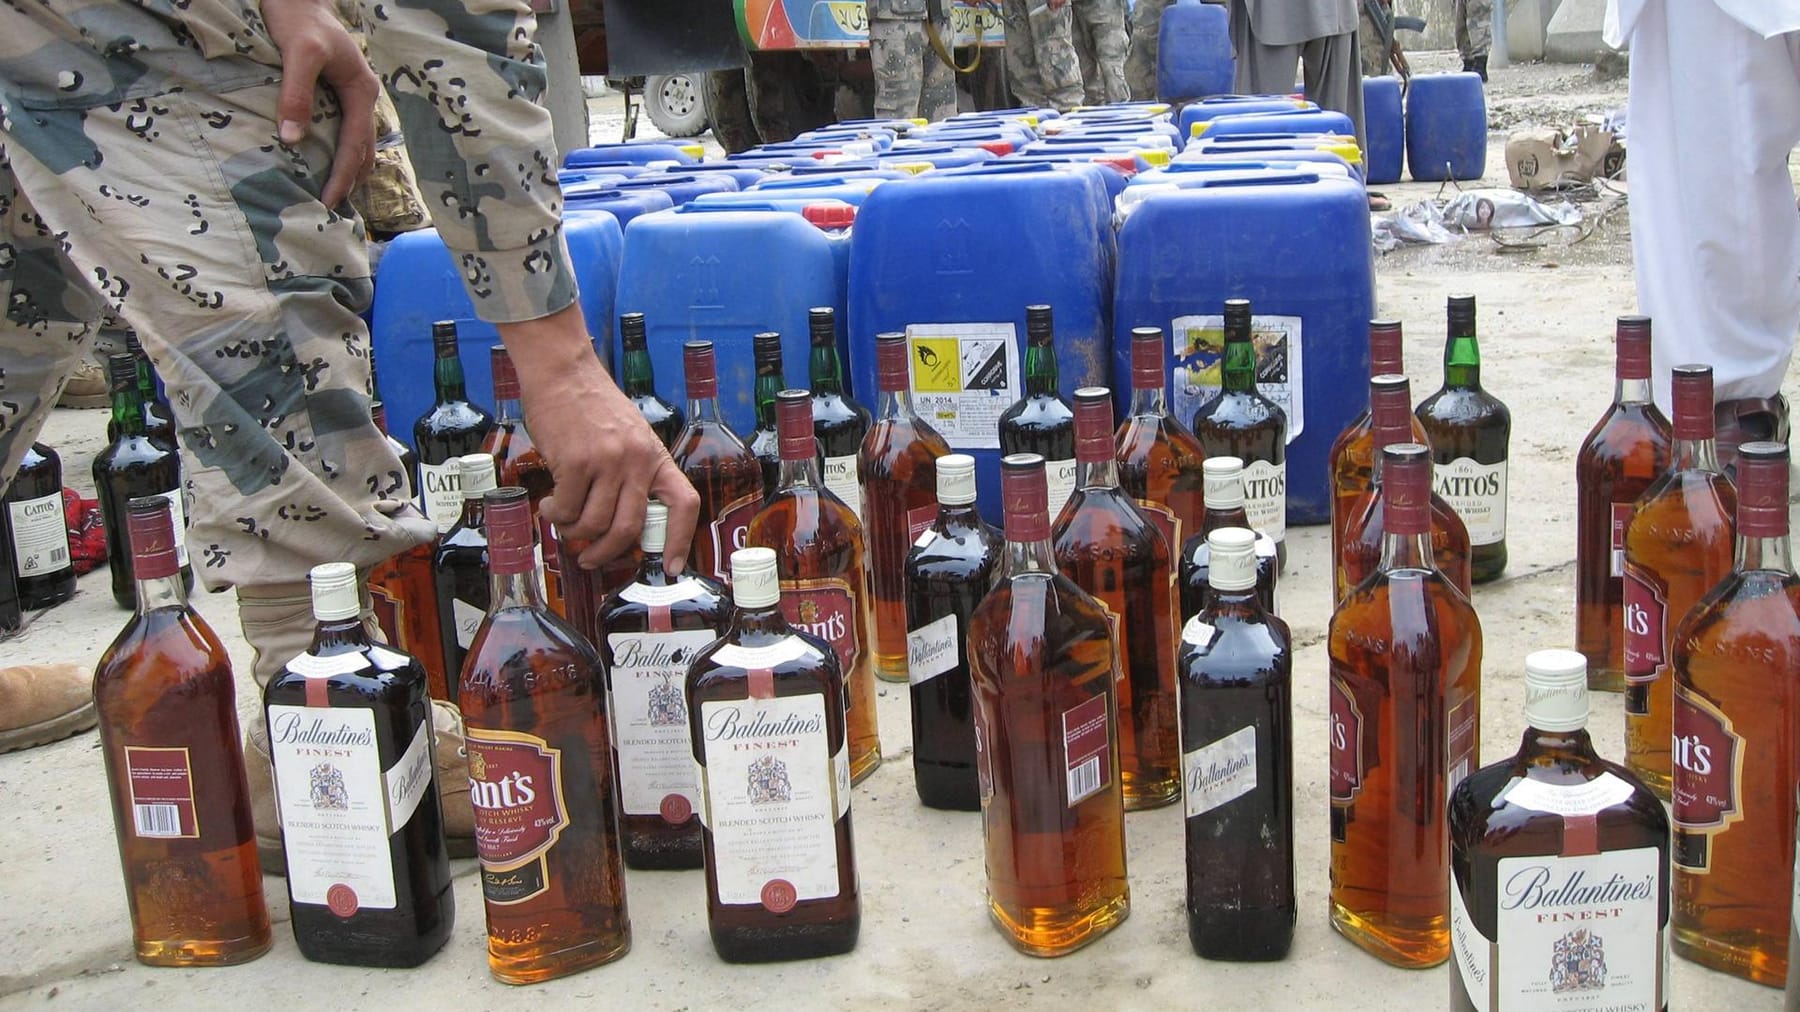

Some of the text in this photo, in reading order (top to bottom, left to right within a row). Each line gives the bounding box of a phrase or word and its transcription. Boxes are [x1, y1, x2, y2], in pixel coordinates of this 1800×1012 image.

[274, 711, 373, 746] Ballantine's
[706, 706, 822, 742] Ballantine's
[296, 748, 353, 758] FINEST
[733, 739, 800, 751] FINEST
[1187, 753, 1250, 793] Ballantine's
[718, 813, 826, 828] BLENDED SCOTCH WHISKY
[1500, 864, 1654, 910] Ballantine's
[1536, 907, 1624, 924] FINEST
